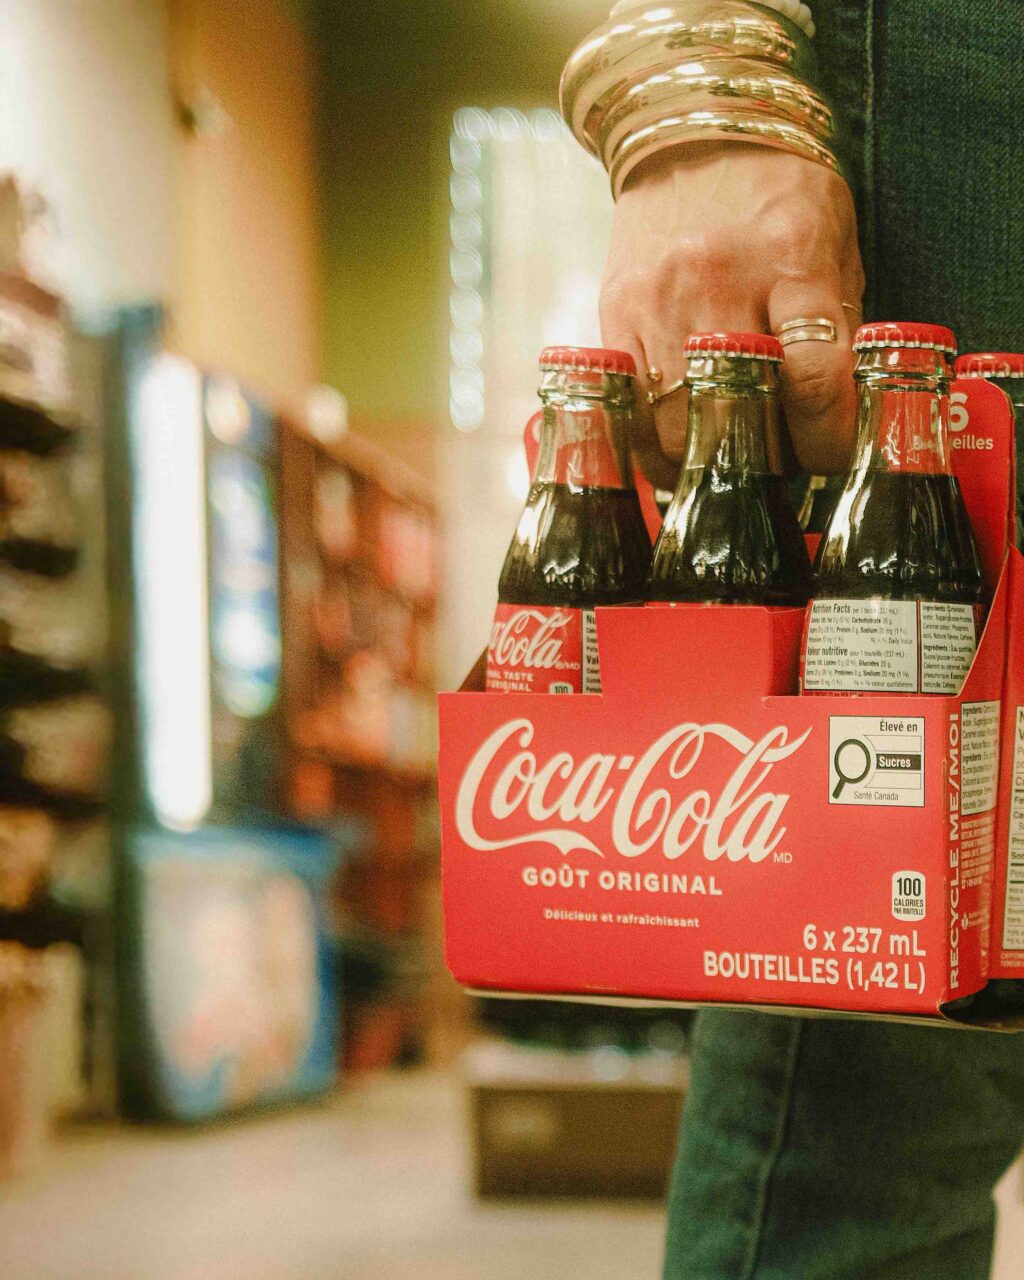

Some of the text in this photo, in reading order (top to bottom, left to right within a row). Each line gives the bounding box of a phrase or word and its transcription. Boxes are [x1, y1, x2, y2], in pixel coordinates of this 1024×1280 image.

[833, 603, 851, 614] Facts
[821, 645, 848, 656] nutritive
[504, 671, 534, 682] TASTE
[862, 669, 881, 677] Sodium
[879, 719, 918, 733] Élevé en
[879, 755, 911, 769] Sucres
[456, 718, 813, 864] Coca-Cola MD
[853, 789, 899, 802] Santé Canada
[949, 713, 959, 989] RECYCLE ME/MOI
[522, 863, 724, 896] GOÛT ORIGINAL
[896, 877, 921, 897] 100
[893, 898, 924, 908] CALORIES
[544, 908, 700, 929] Délicieux et rafraîchissant
[803, 924, 927, 957] 6 x 237 mL
[703, 950, 926, 994] BOUTEILLES (1,42 L)
